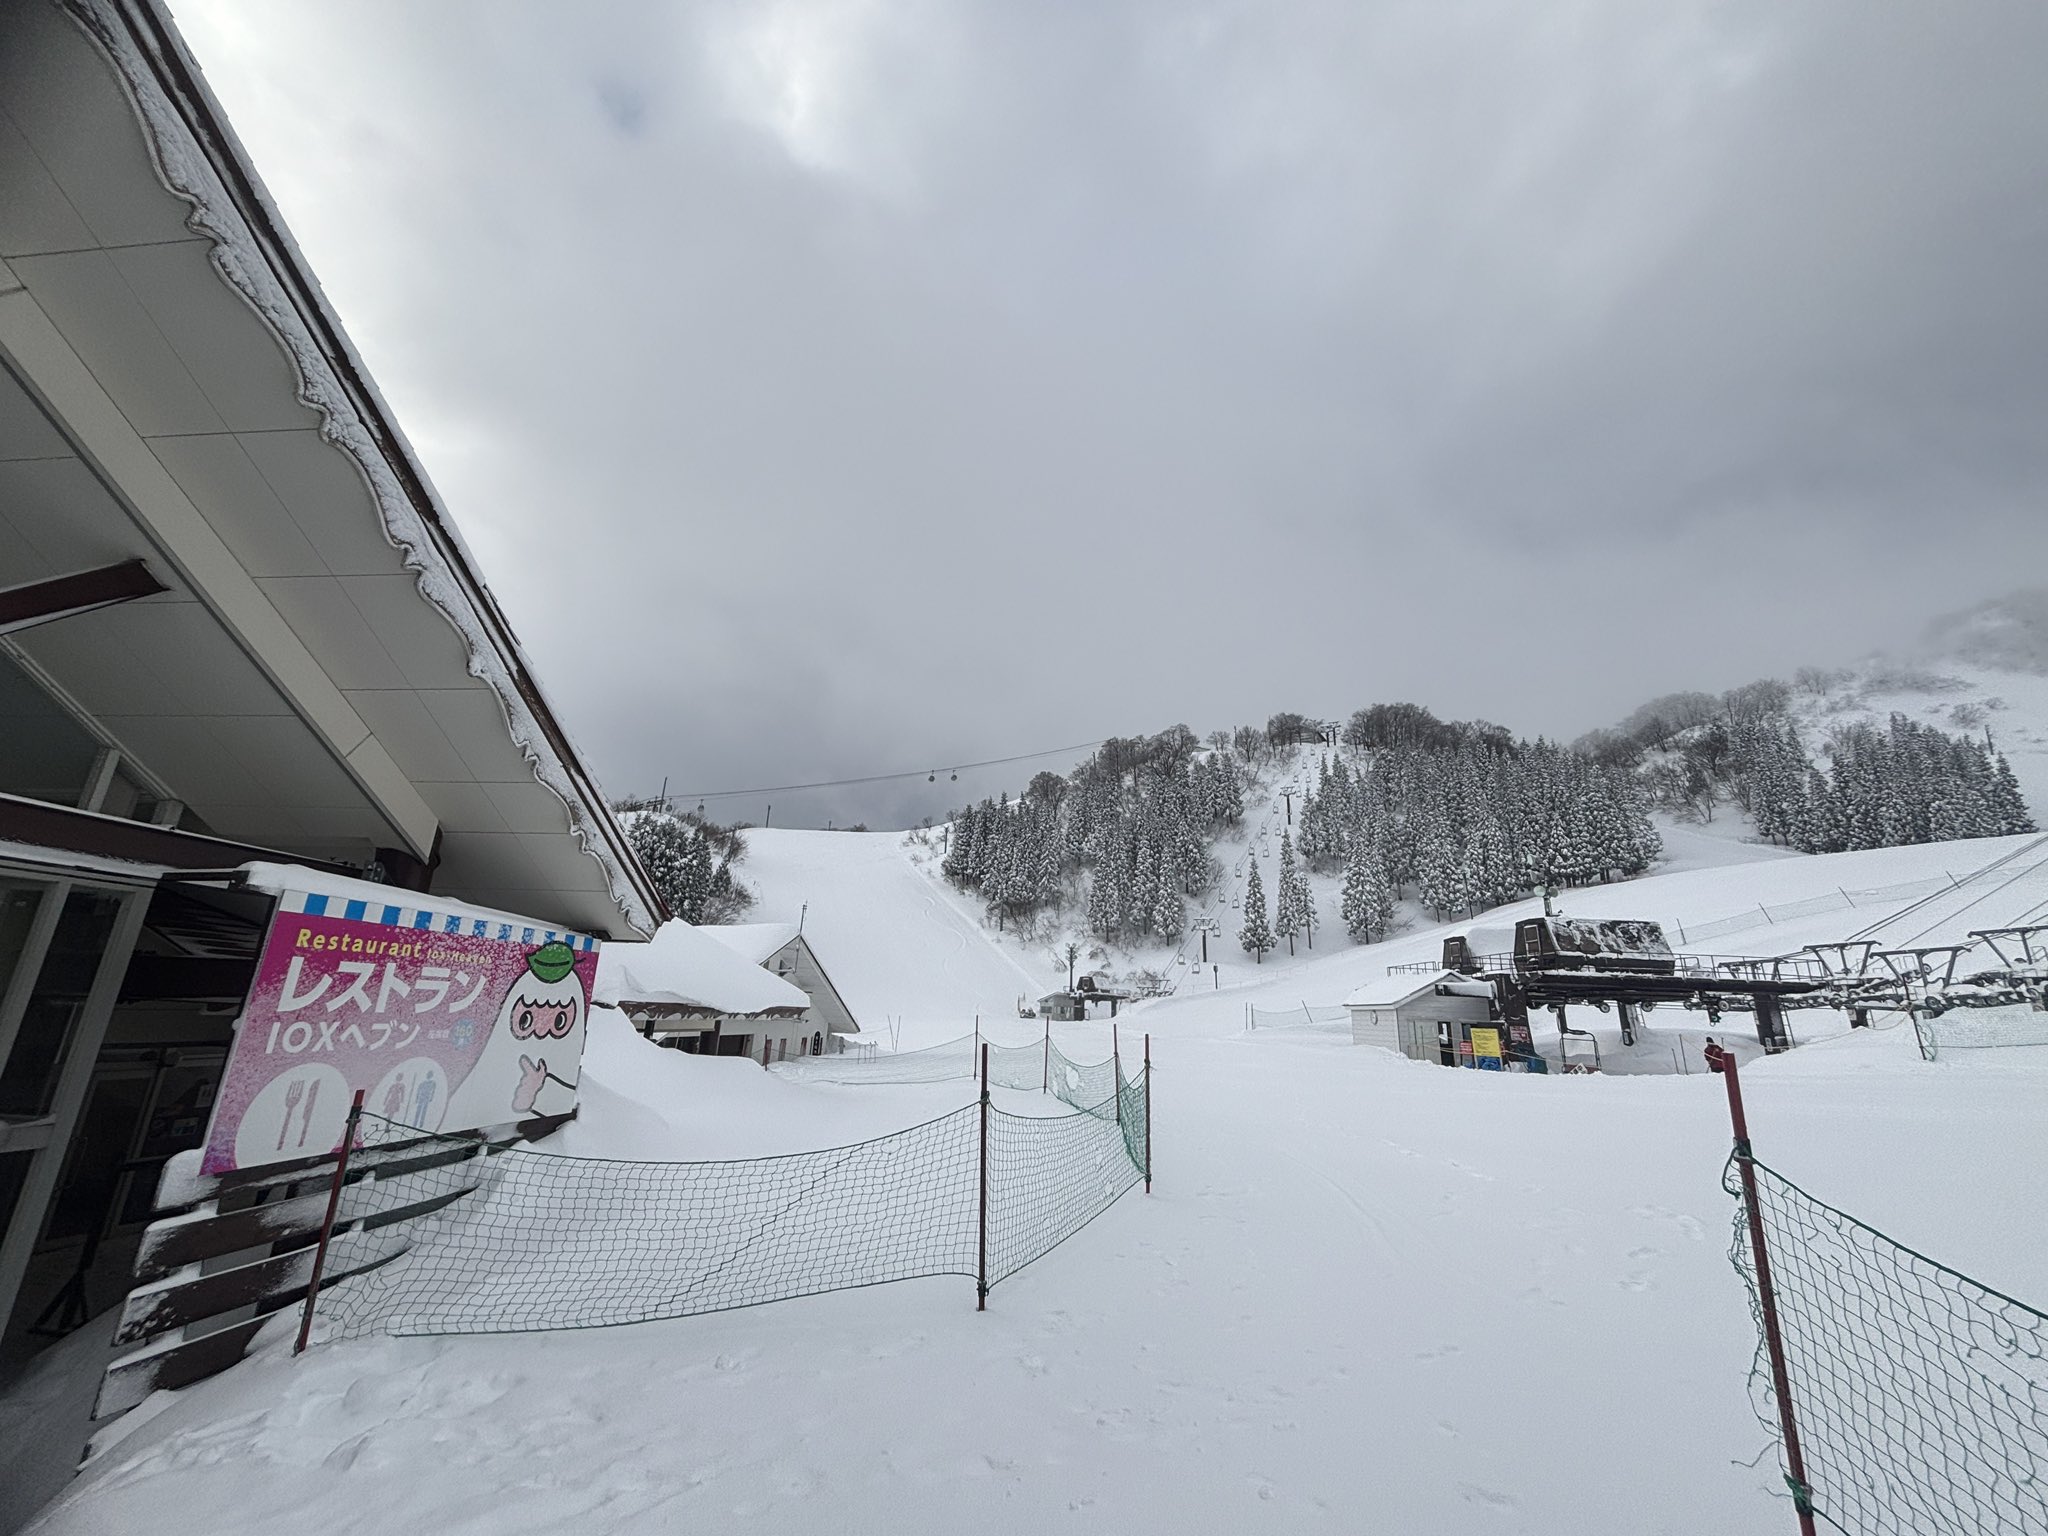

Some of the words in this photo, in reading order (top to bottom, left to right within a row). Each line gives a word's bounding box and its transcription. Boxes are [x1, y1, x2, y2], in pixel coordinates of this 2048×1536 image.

[296, 928, 422, 958] Restaurant
[277, 956, 487, 1013] レストラン
